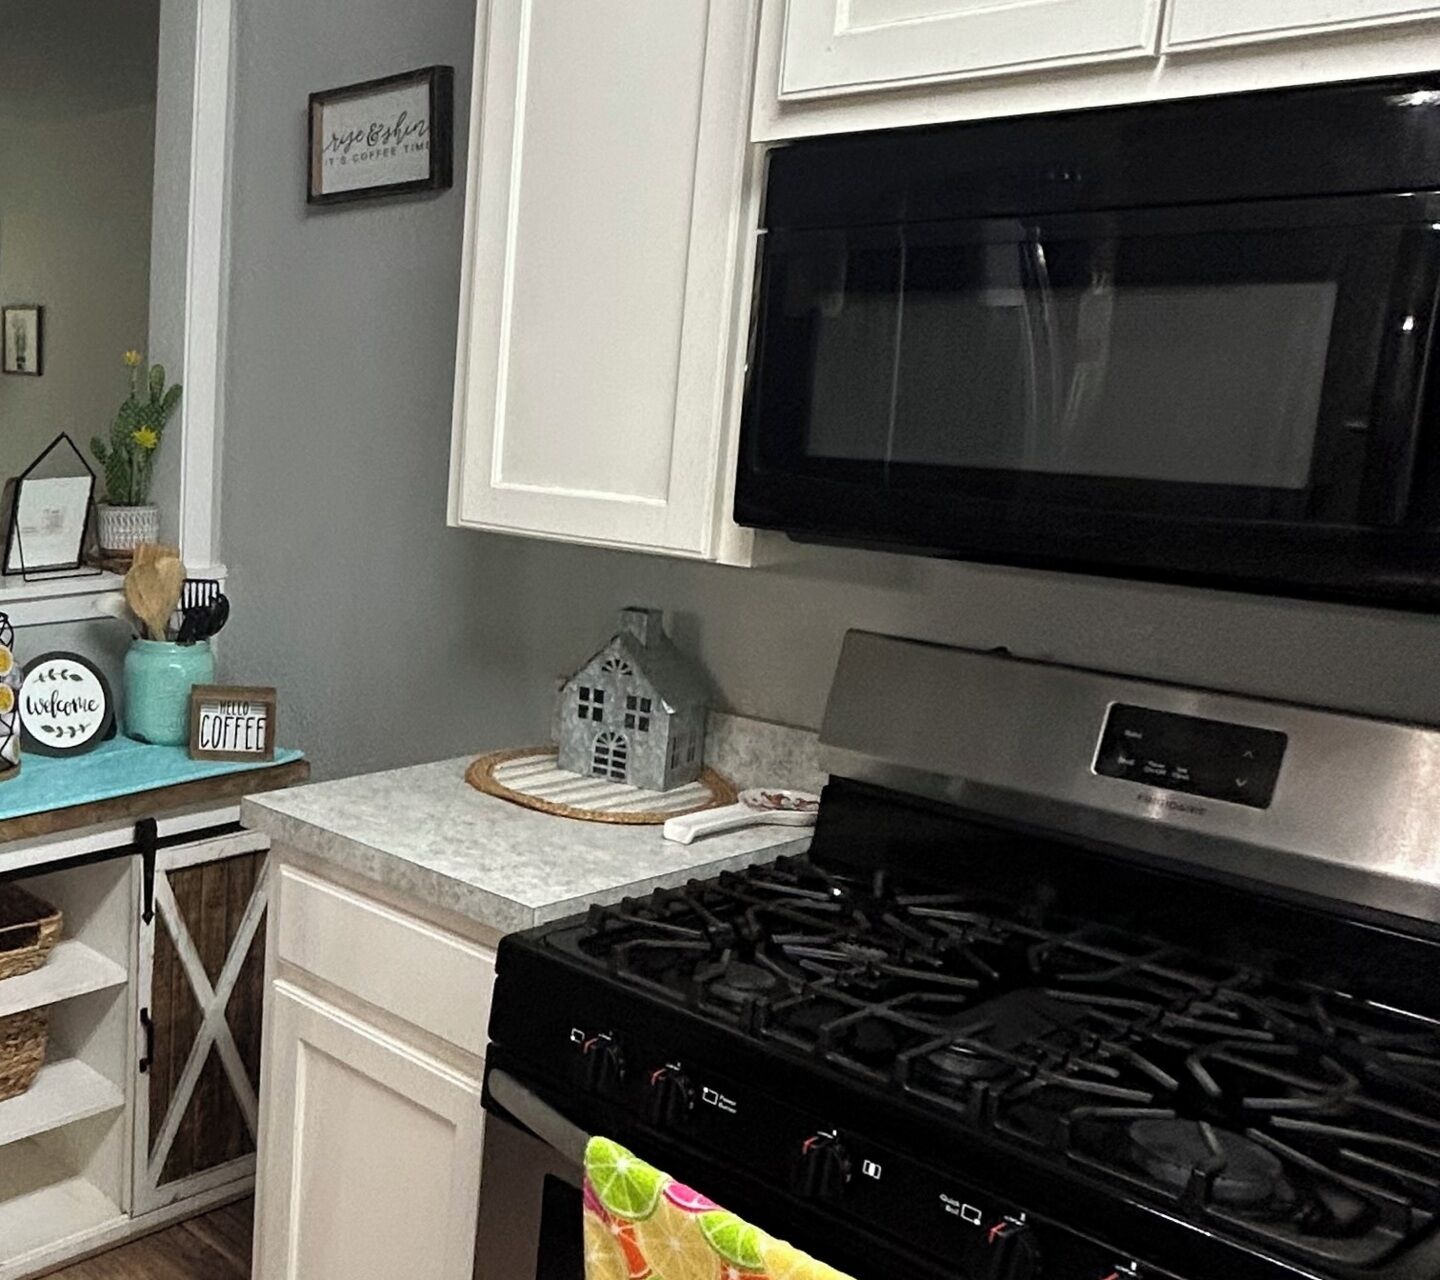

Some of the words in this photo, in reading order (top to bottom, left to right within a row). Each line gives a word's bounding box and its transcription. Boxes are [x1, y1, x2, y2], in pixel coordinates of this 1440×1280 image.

[381, 110, 429, 145] shin
[352, 146, 397, 163] COFFEE
[219, 700, 250, 715] HELLO
[200, 714, 266, 751] COFFEE
